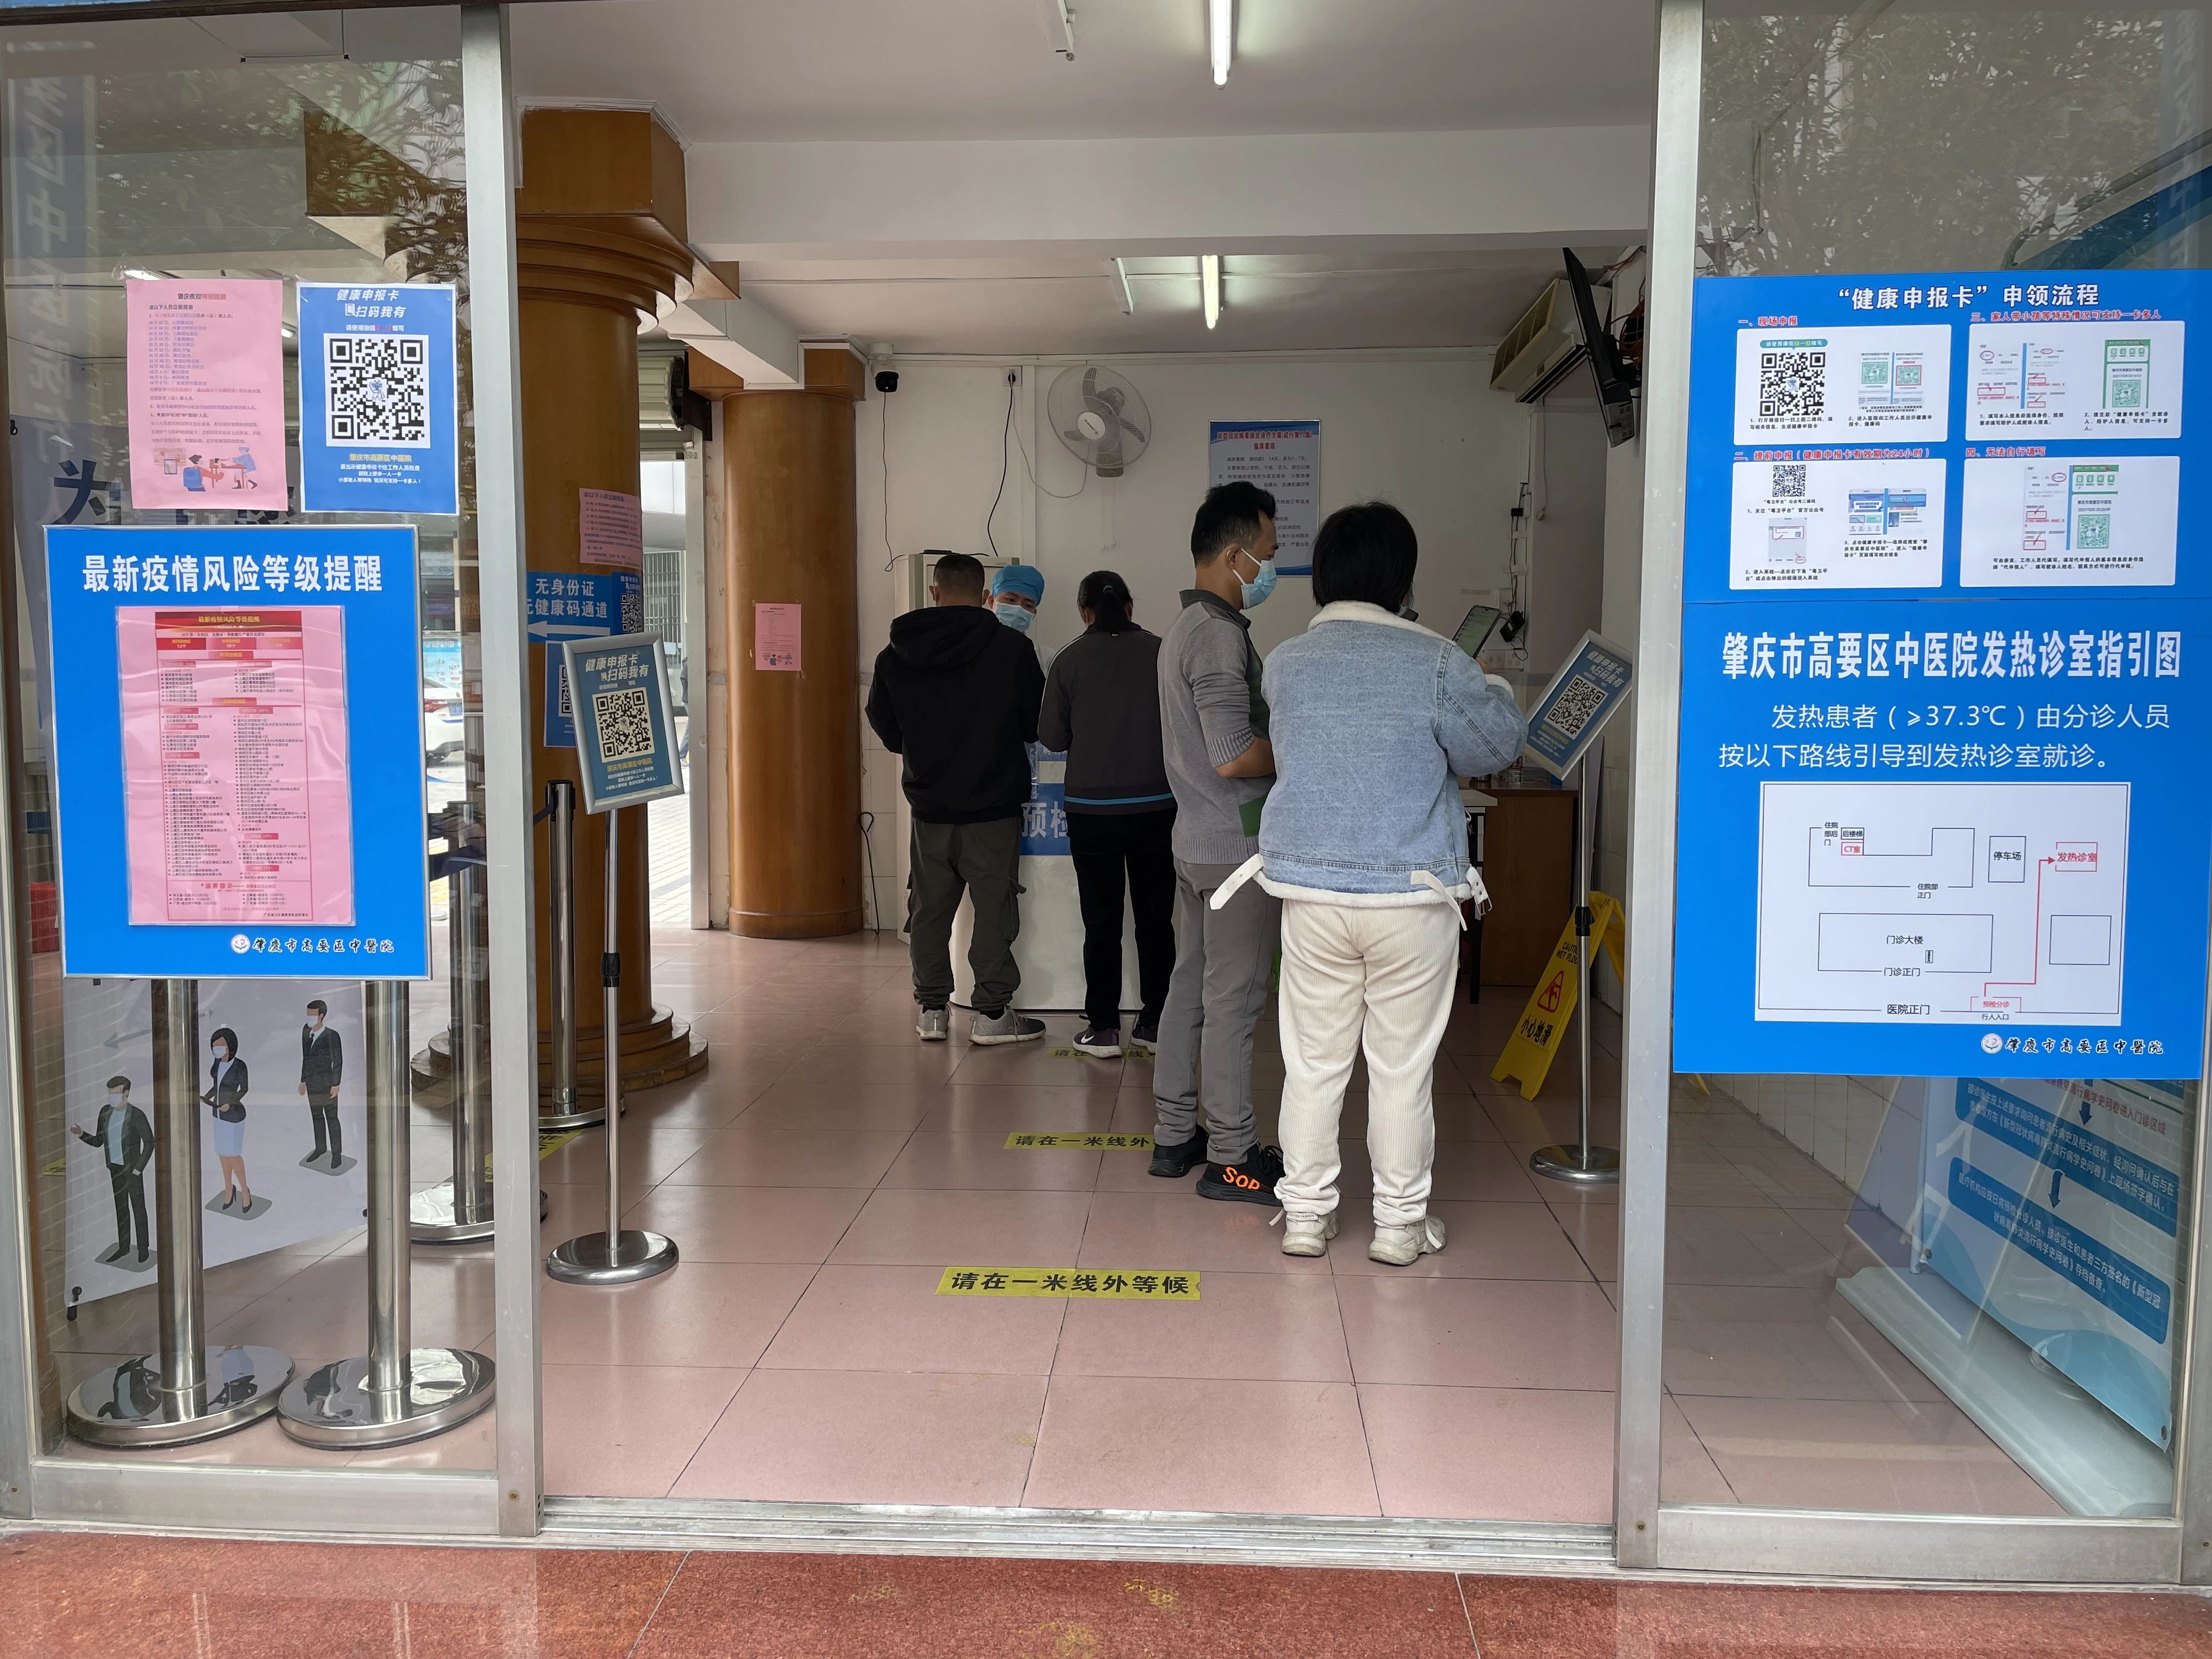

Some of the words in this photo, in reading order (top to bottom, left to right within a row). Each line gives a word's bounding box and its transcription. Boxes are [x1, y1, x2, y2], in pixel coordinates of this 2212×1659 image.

[337, 289, 399, 301] 健康申报卡
[1839, 285, 1987, 310] “健康申报卡”
[2003, 284, 2100, 307] 申领流程
[356, 306, 407, 318] 扫码我有
[1739, 316, 1798, 327] 一、现场申报
[1966, 447, 2046, 457] 四、无法自行填写
[83, 555, 382, 592] 最新疫情风险等级提醒
[535, 578, 595, 597] 无身份证
[1722, 630, 2182, 680] 肇庆市高要区中医院发热诊室指引图
[585, 654, 638, 672] 健康申报卡
[607, 664, 649, 681] 扫码我有
[1719, 742, 2108, 769] 按以下路线引导到发热诊室就诊。
[1993, 851, 2022, 861] 停车场
[2057, 853, 2097, 863] 发热诊室
[1886, 935, 1924, 945] 门诊大楼
[1556, 950, 1567, 959] WET
[1883, 968, 1921, 977] 门诊正门
[1886, 1005, 1930, 1015] 医院正门
[1983, 1000, 2010, 1008] 预检分诊
[1520, 1015, 1554, 1047] 小心地滑
[1015, 1135, 1155, 1148] 请在一米线外
[951, 1272, 1189, 1294] 请在一米线外等候
